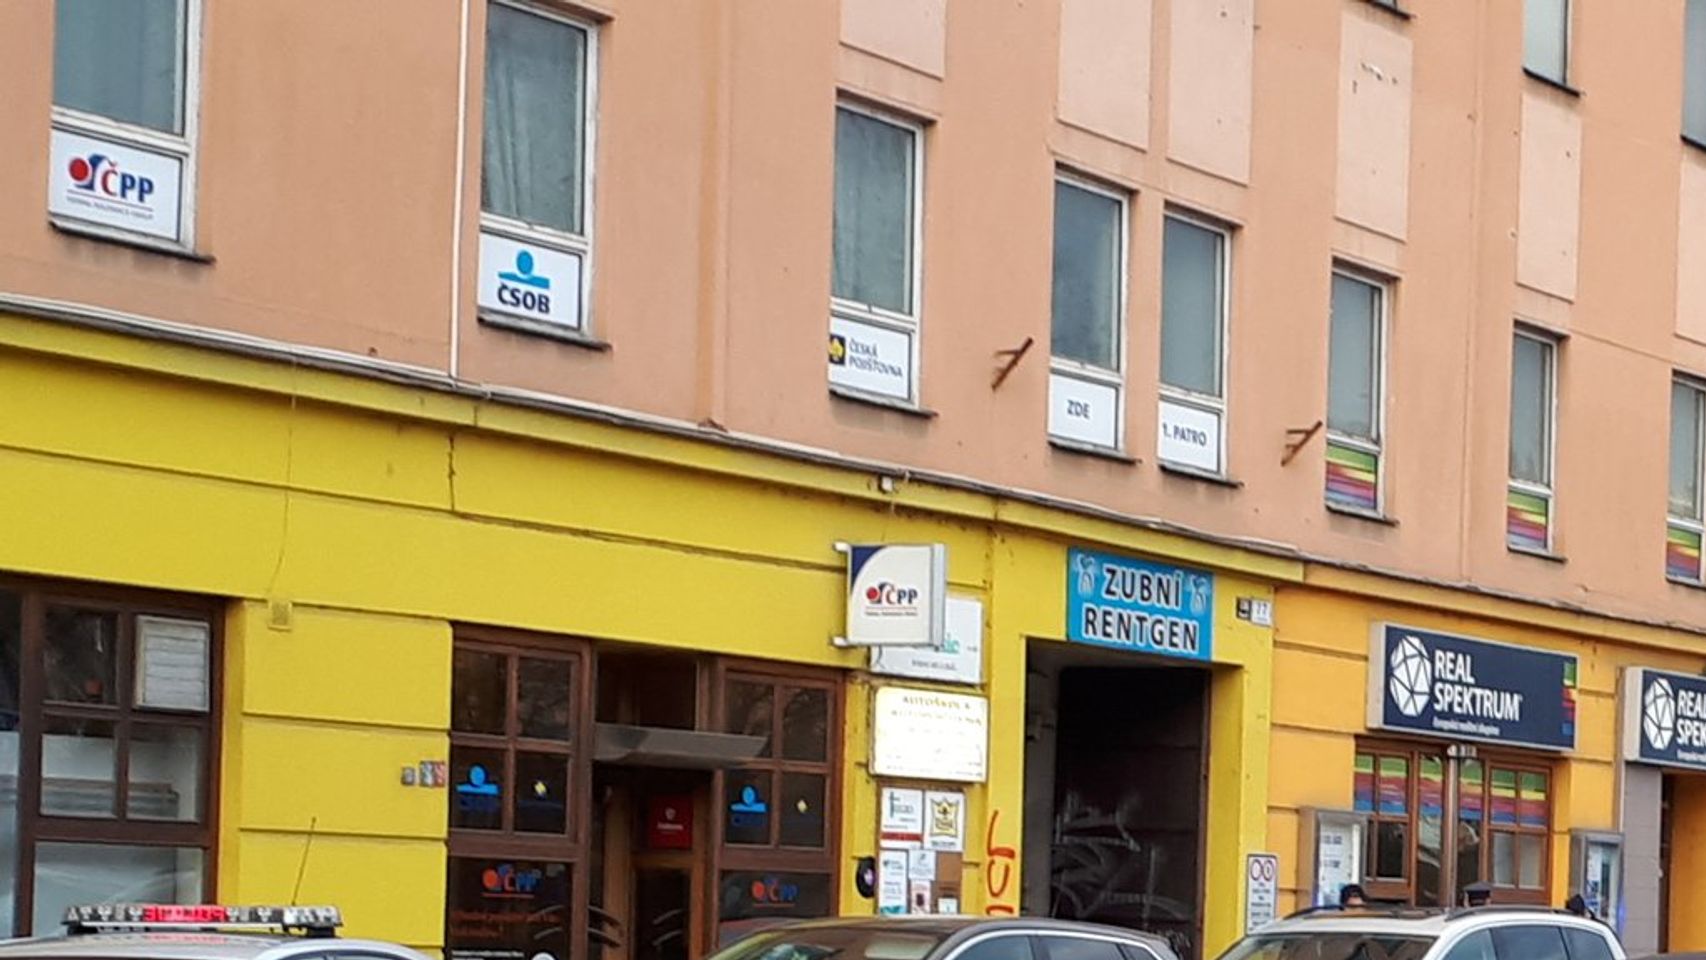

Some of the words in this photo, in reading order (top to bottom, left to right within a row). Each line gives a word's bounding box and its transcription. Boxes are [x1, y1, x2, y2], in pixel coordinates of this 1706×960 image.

[101, 161, 154, 203] ČPP
[497, 283, 550, 314] ČSOB
[1067, 400, 1091, 419] ZDE
[1163, 422, 1171, 438] 1.
[1174, 425, 1207, 447] PATRO
[1103, 566, 1182, 608] ZUBNÍ
[1083, 606, 1198, 651] RENTGEN
[1434, 650, 1475, 684] REAL
[1433, 682, 1521, 722] SPEKTRUM
